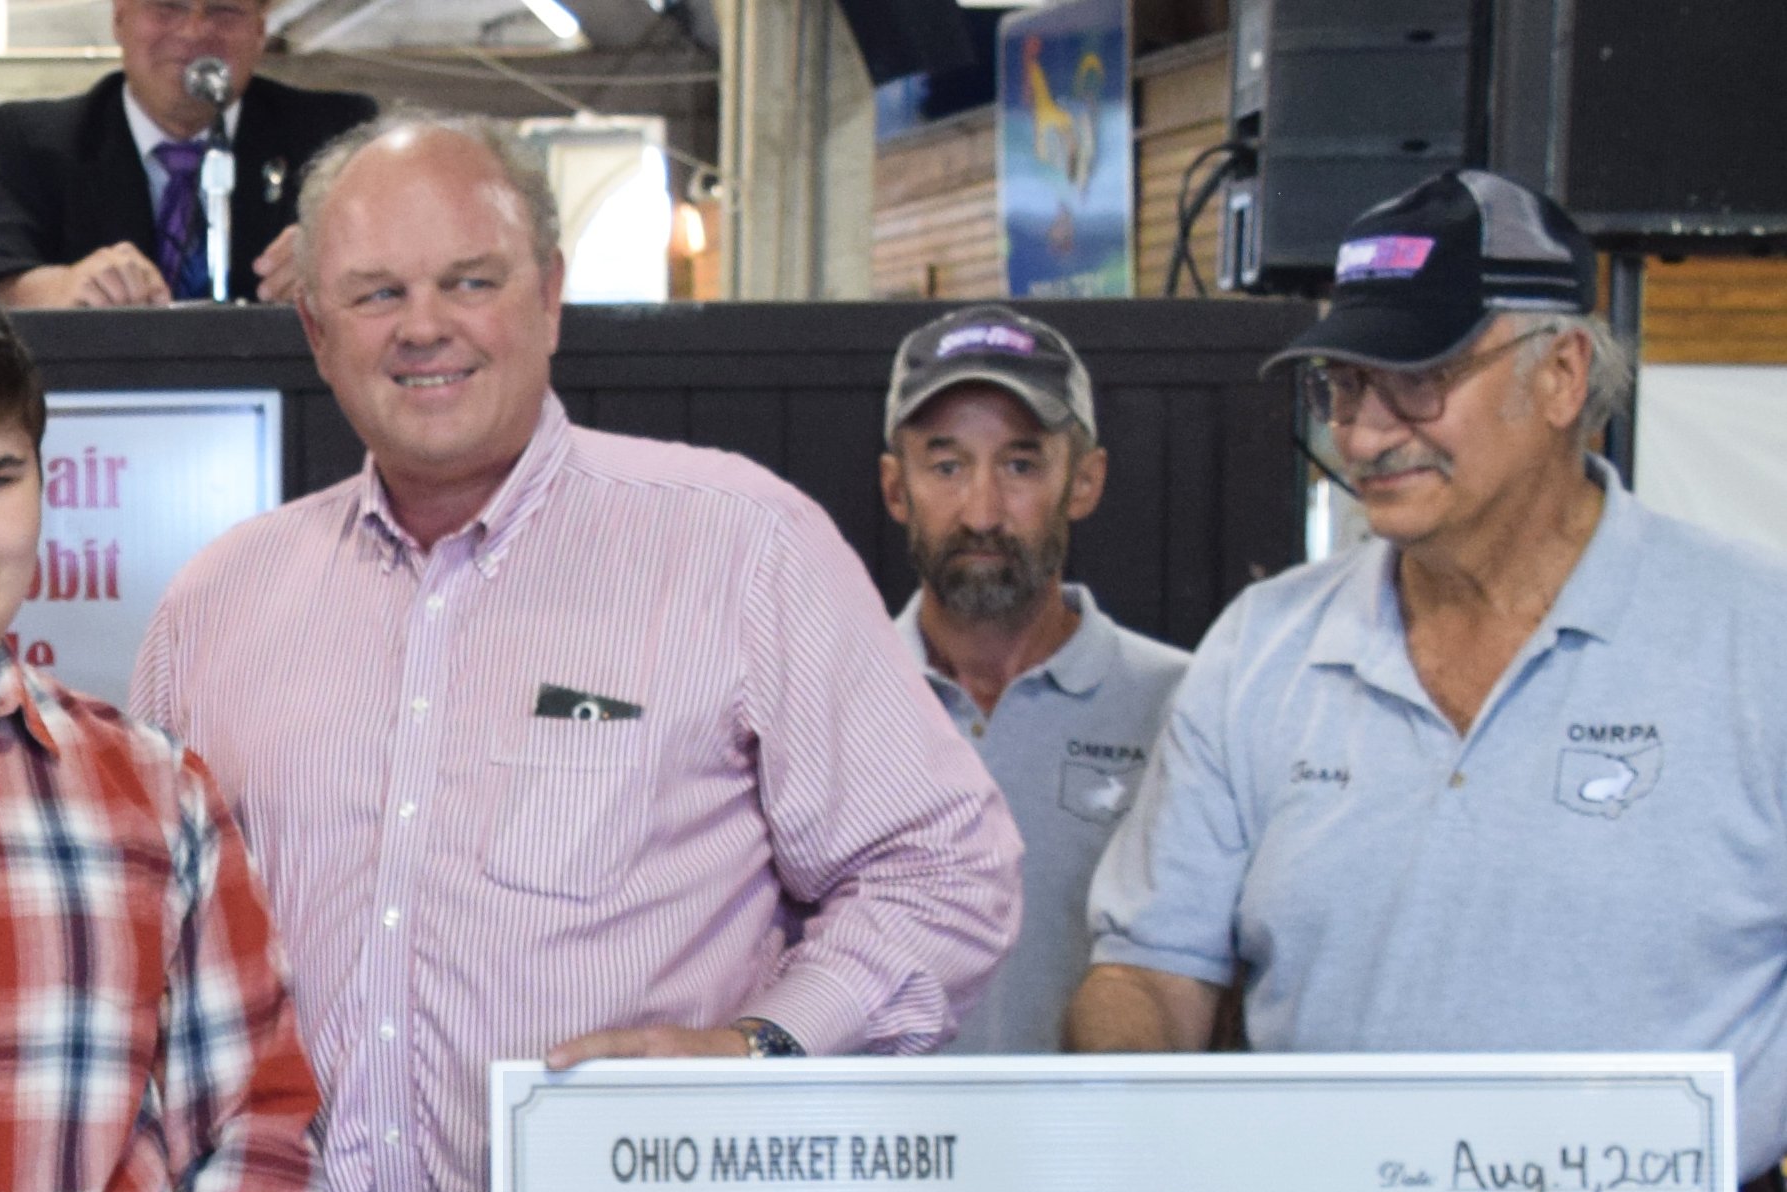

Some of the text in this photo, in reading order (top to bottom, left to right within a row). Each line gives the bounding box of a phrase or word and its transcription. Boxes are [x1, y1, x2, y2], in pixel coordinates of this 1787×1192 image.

[46, 446, 127, 509] air
[1567, 723, 1659, 742] OMRPA
[611, 1133, 958, 1183] OHIO MARKET RABBIT
